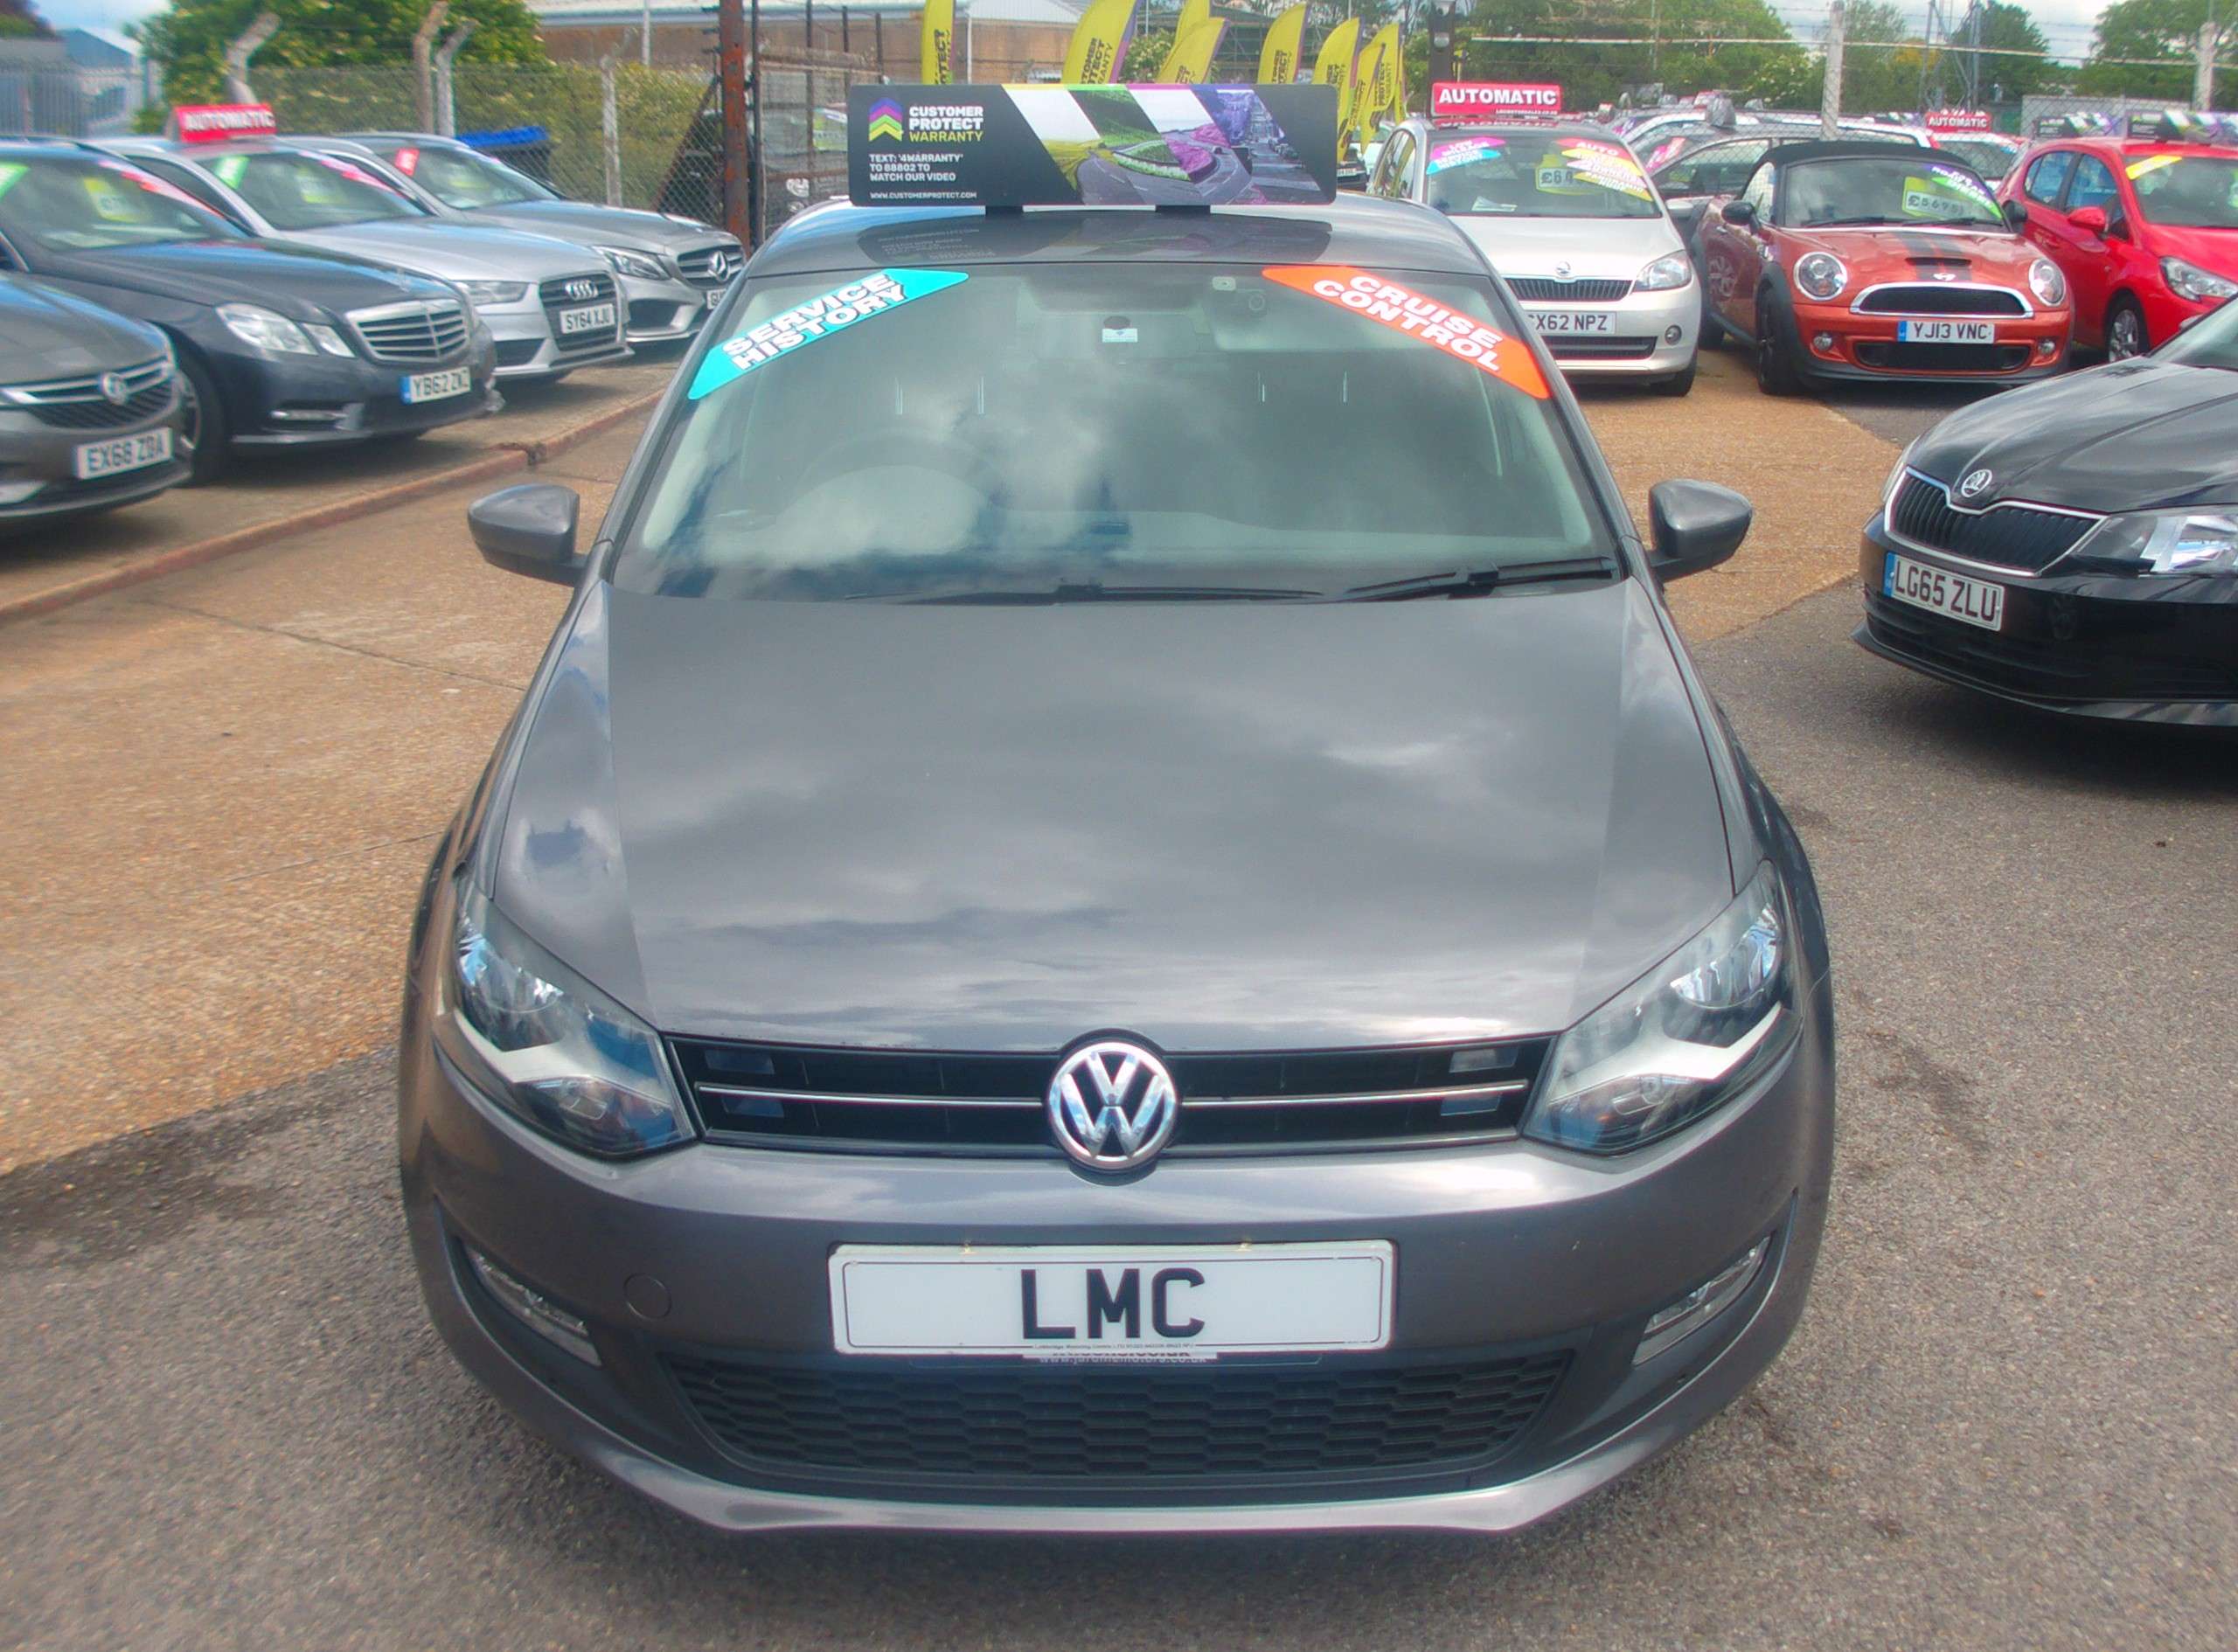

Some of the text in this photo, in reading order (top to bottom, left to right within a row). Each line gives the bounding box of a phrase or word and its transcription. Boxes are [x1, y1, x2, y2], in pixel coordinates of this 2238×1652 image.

[1439, 88, 1557, 105] AUTOMATIC
[909, 106, 983, 117] CUSTOMER
[184, 111, 276, 132] AUTOMATIC
[909, 117, 983, 130] PROTECT
[1929, 116, 1987, 128] AUTOMATIC
[909, 131, 983, 142] WARRANTY
[869, 163, 883, 172] TO
[917, 163, 930, 172] TO
[870, 173, 956, 182] WATCH OUR VIDEO
[723, 274, 896, 356] SERVICE
[1350, 276, 1503, 350] CRUISE
[733, 284, 907, 370] HISTORY
[1313, 280, 1500, 371] CONTROL
[1528, 314, 1608, 330] X62 NPZ
[1914, 323, 1988, 340] YJ13 VNC
[1895, 559, 1998, 622] LG65 ZLU
[1020, 1267, 1206, 1340] LMC
